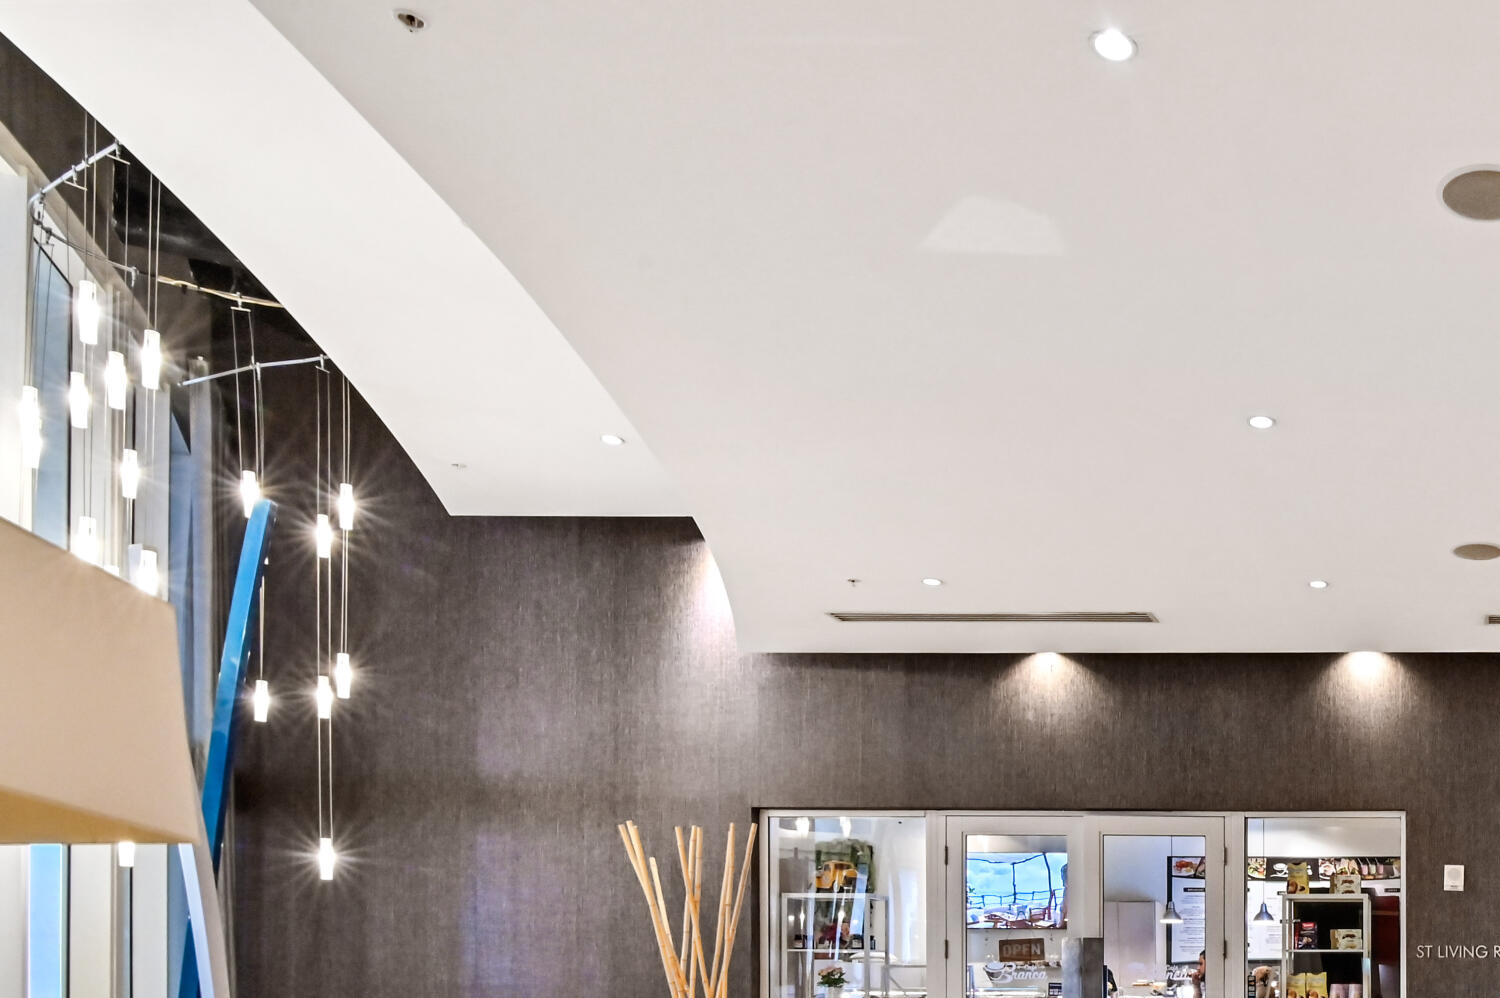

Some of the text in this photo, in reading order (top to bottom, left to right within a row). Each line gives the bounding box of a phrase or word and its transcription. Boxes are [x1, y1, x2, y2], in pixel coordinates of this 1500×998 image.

[1002, 942, 1041, 957] OPEN
[1416, 944, 1433, 959] ST
[1437, 944, 1489, 959] LIVING
